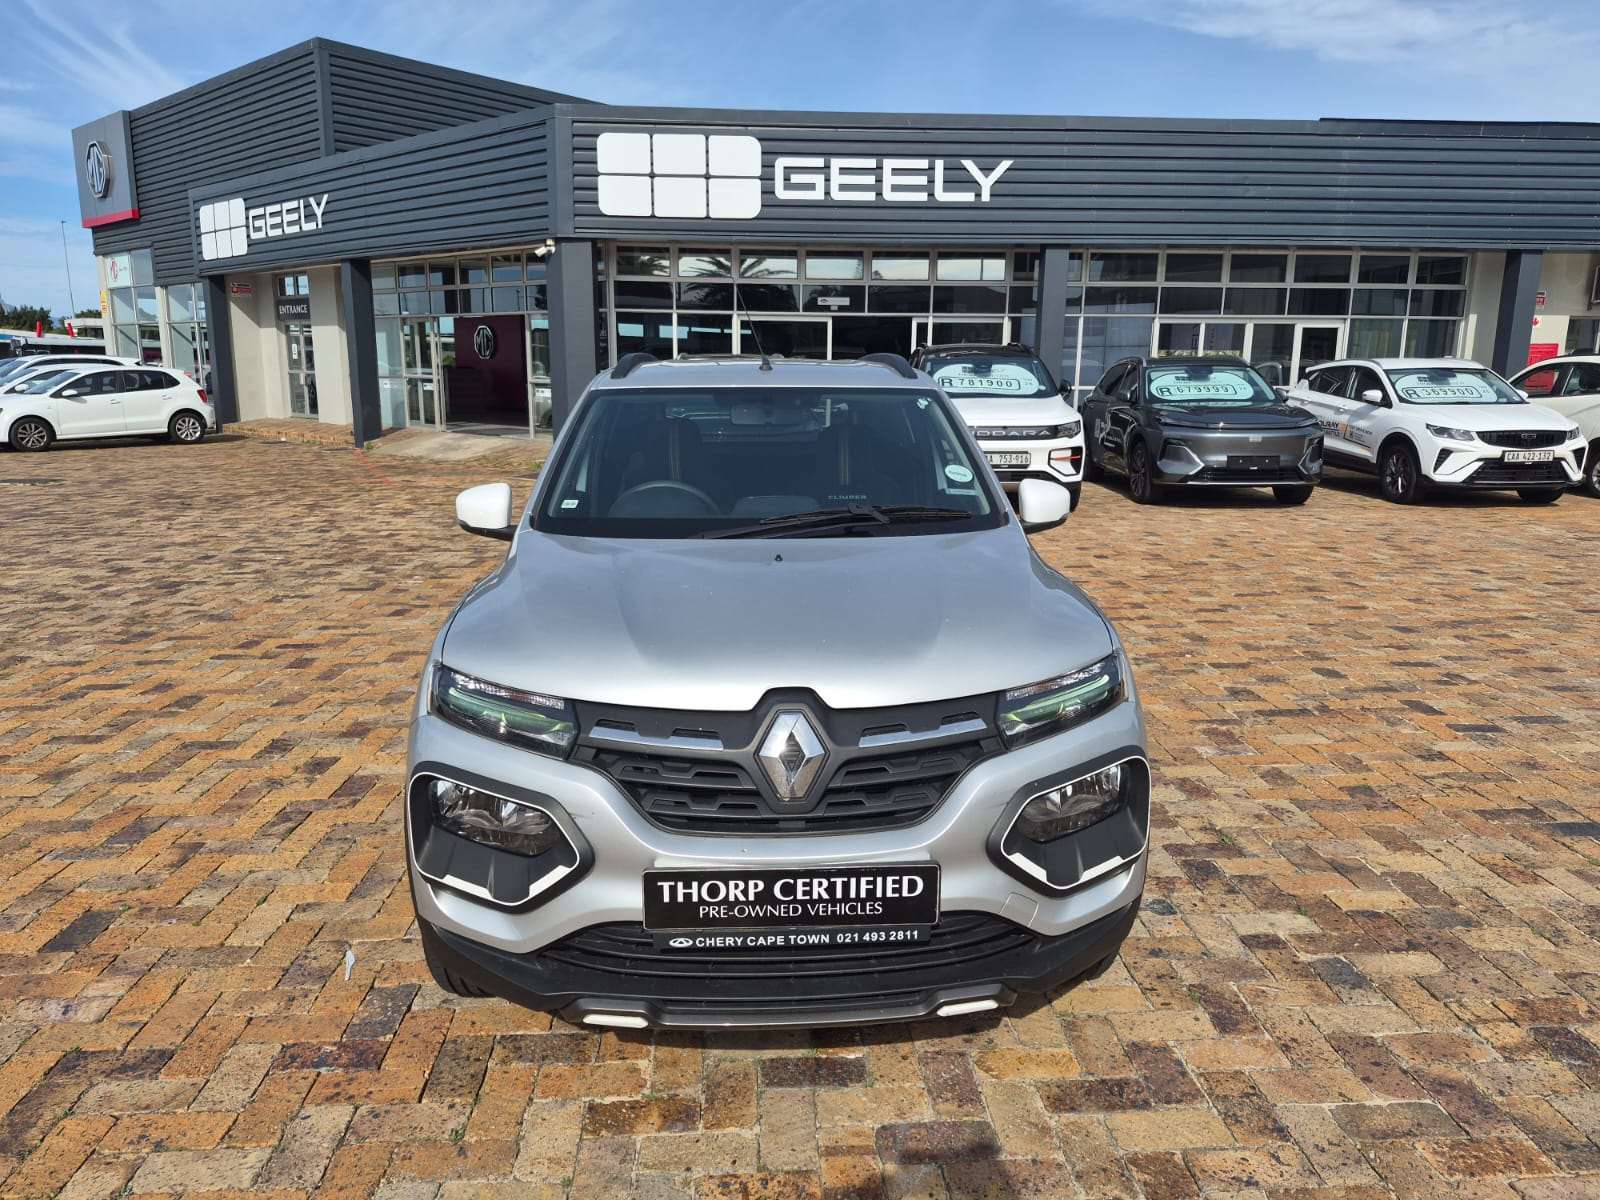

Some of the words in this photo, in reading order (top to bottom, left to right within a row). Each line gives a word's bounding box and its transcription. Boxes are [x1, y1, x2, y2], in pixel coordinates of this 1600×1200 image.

[87, 141, 105, 198] MG
[775, 157, 1014, 202] GEELY
[249, 194, 328, 239] GEELY
[279, 304, 308, 314] ENTRANCE
[474, 326, 494, 359] MG
[941, 378, 953, 387] R
[959, 378, 1013, 388] 781900
[1159, 387, 1172, 396] R
[999, 454, 1029, 464] 753-916
[657, 880, 765, 903] THORP
[773, 875, 924, 901] CERTIFIED
[699, 904, 802, 919] PRE-OWNED
[806, 901, 883, 916] VEHICLES
[695, 937, 744, 947] CHERY
[746, 935, 785, 946] CAPE
[788, 934, 830, 945] TOWN
[836, 932, 859, 943] 021
[862, 931, 886, 942] 493
[889, 930, 918, 941] 2811
